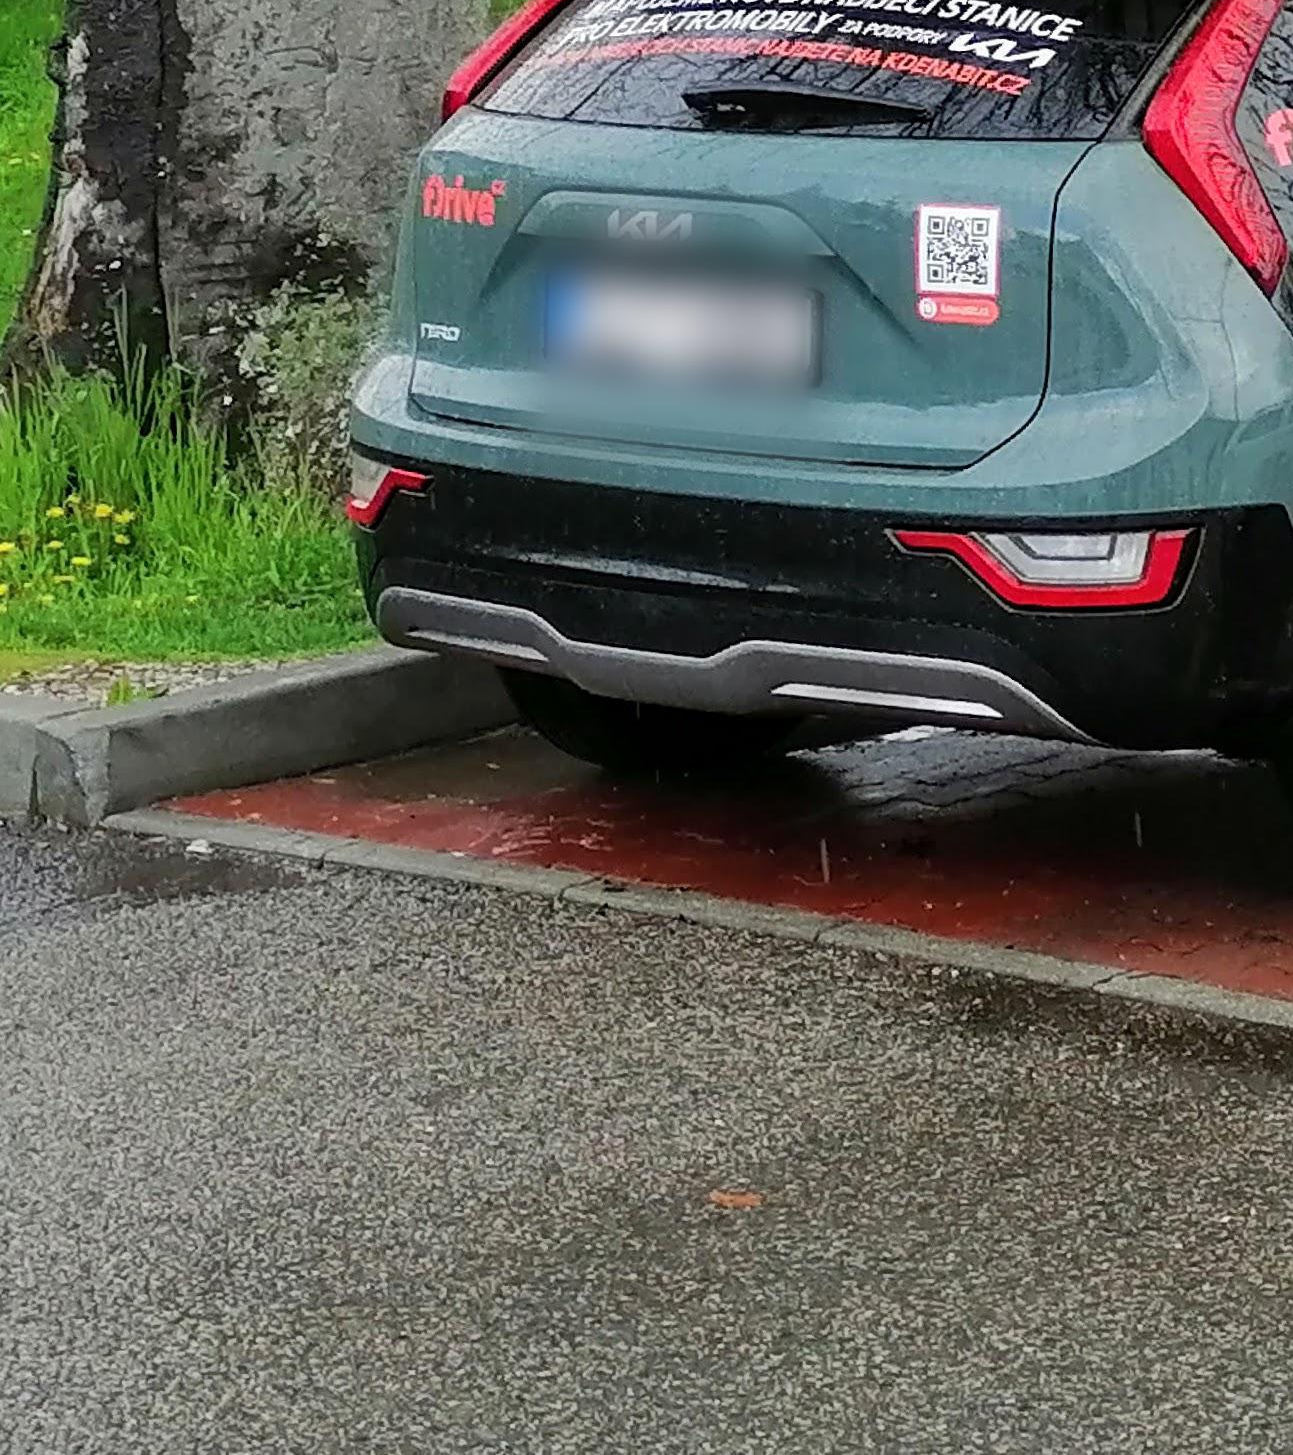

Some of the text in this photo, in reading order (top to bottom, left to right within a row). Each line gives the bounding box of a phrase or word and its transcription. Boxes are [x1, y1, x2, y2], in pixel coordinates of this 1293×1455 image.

[607, 8, 845, 37] ELEKTROMOBILY
[837, 19, 864, 35] ZA
[881, 51, 1032, 96] KDENABIT.CZ
